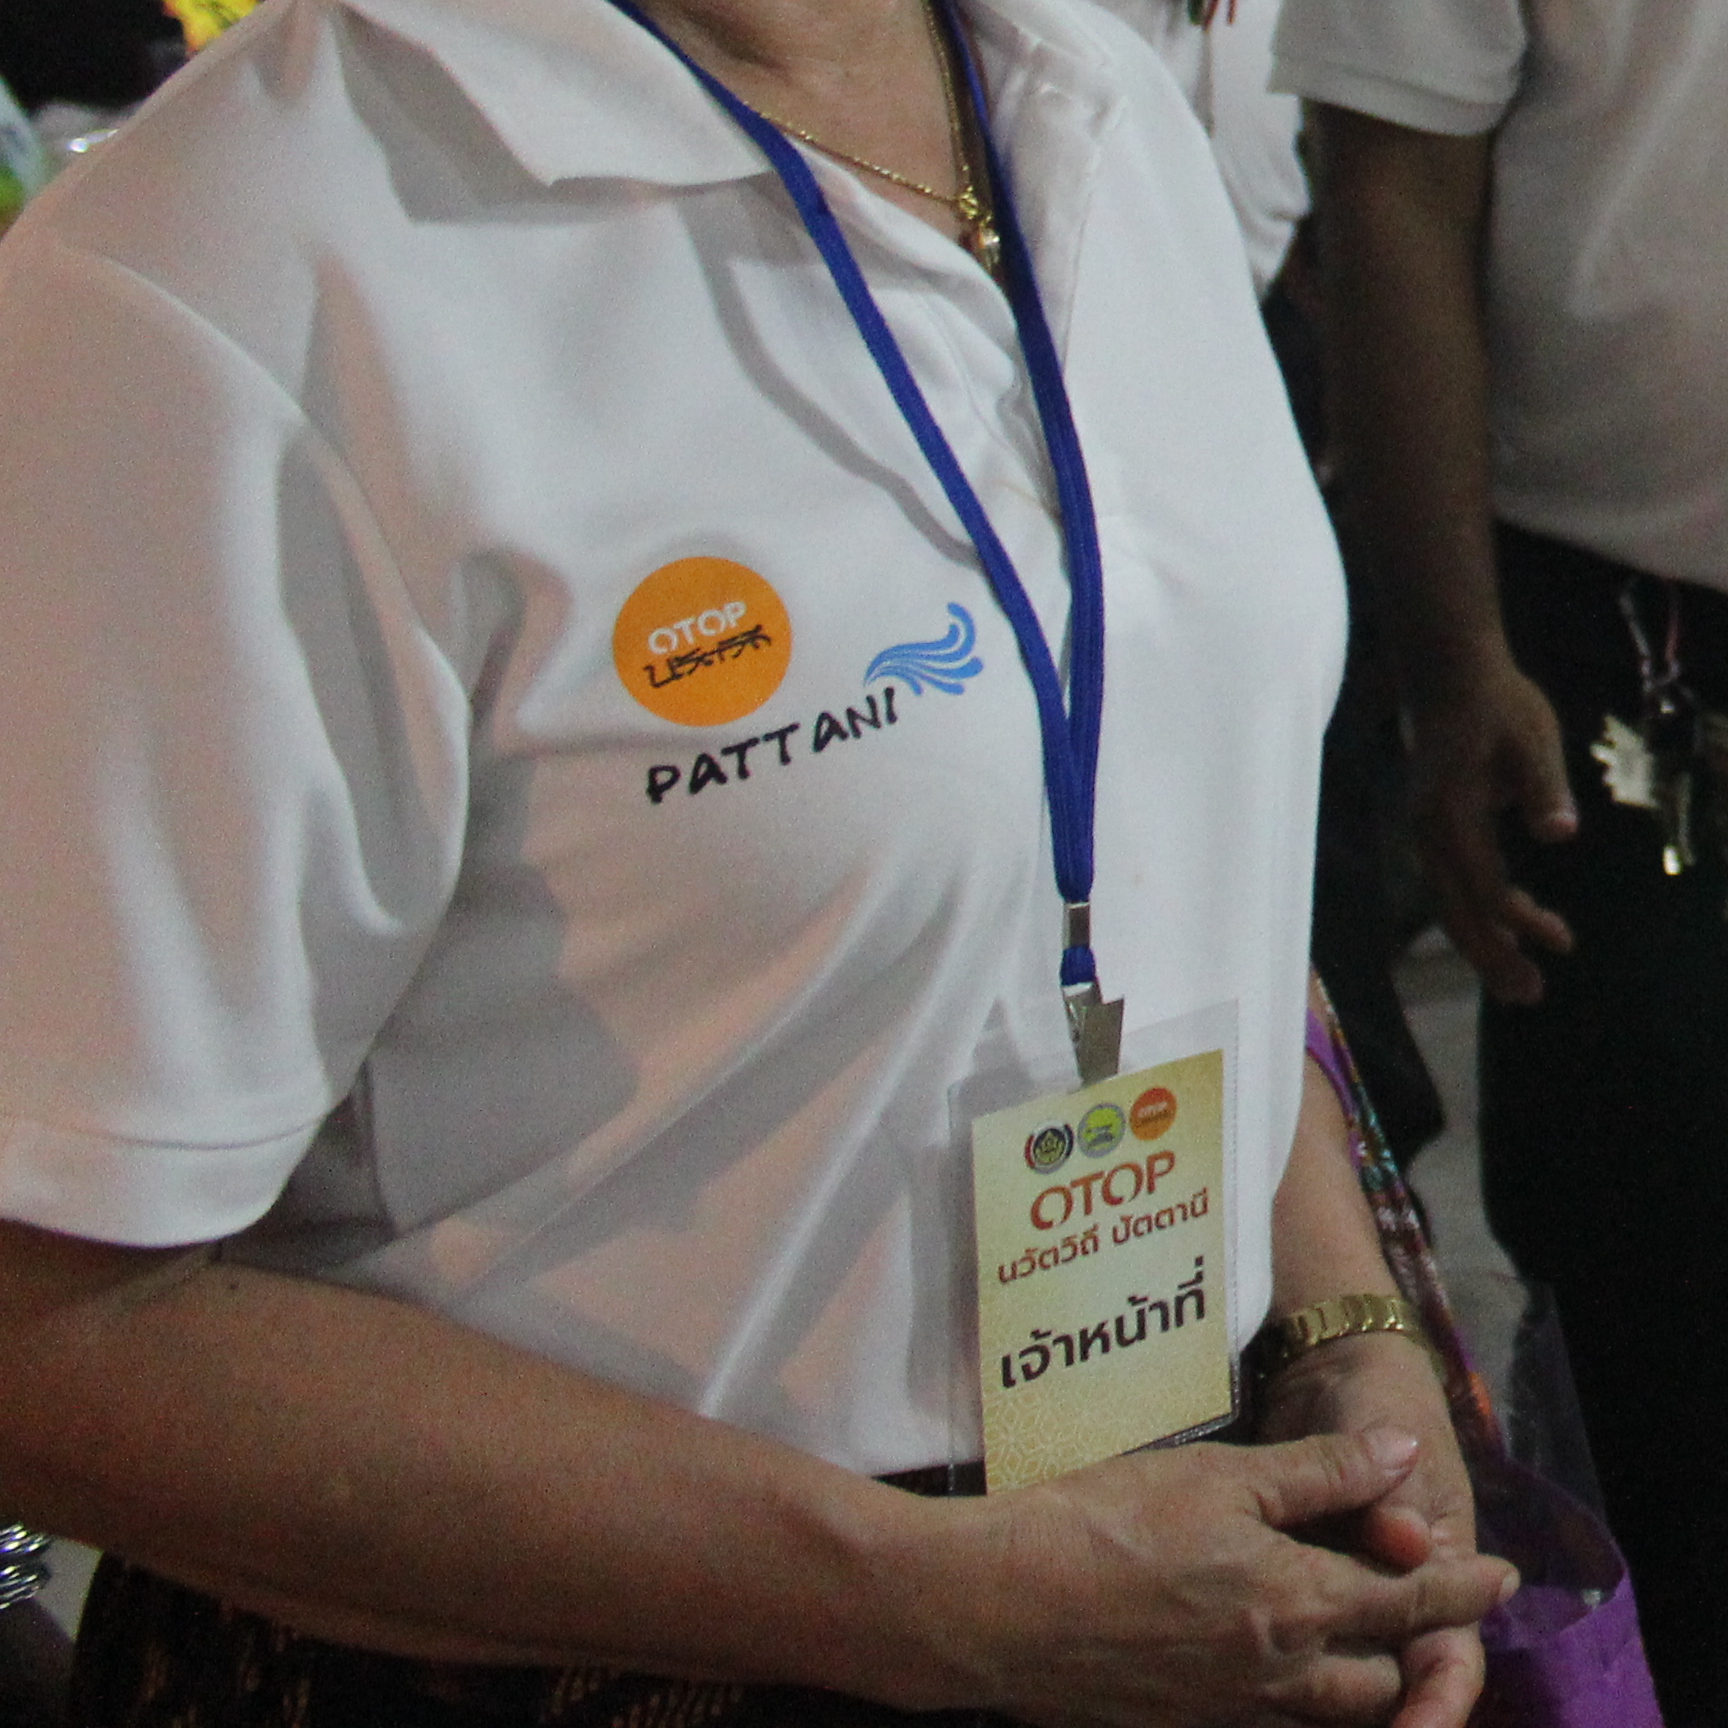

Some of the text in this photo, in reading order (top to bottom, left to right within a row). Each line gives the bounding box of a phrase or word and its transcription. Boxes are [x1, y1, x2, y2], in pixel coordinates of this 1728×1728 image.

[647, 599, 748, 656] OTOP
[645, 685, 899, 805] PATTANI
[998, 1186, 1210, 1284] นวัตวิถี ปัตตานี
[1030, 1150, 1176, 1231] OTOP
[1001, 1254, 1206, 1389] เจ้าหน้าที่
